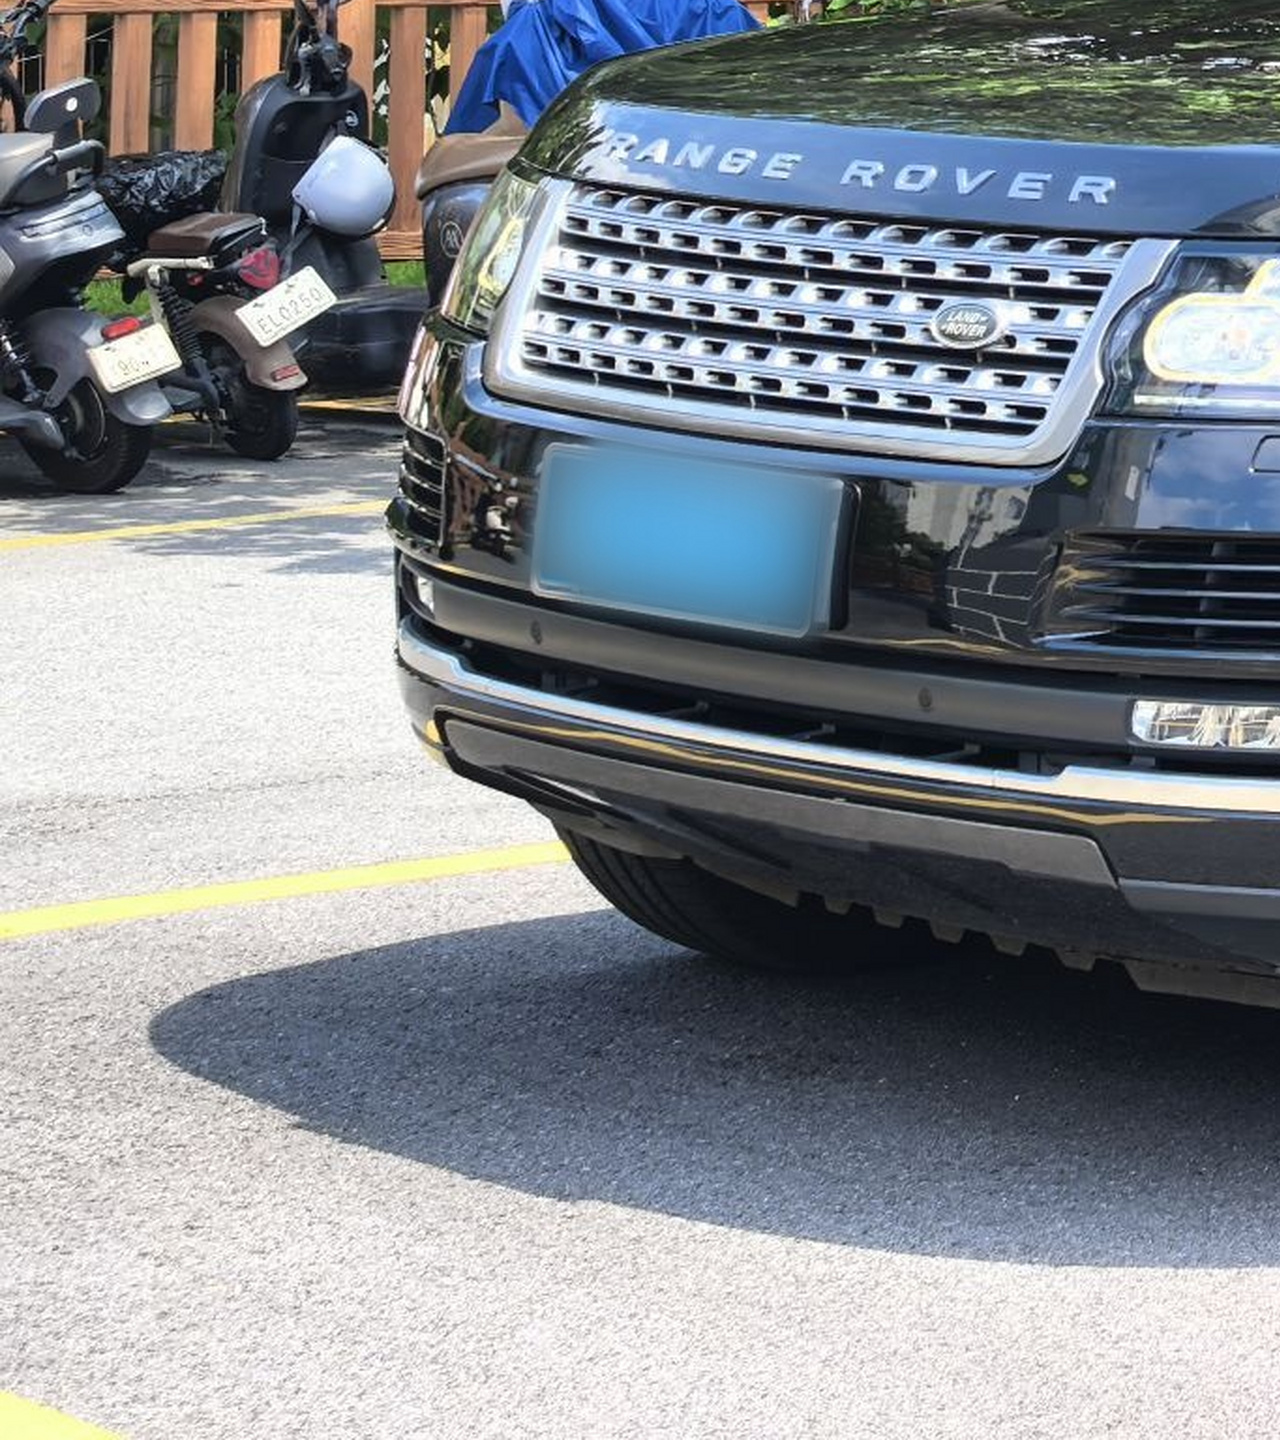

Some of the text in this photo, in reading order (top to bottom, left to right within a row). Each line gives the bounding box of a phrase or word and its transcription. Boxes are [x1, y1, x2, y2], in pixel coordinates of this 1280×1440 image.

[601, 132, 1117, 205] RANGE ROVER
[946, 310, 981, 323] LAND
[944, 322, 988, 338] ROVER
